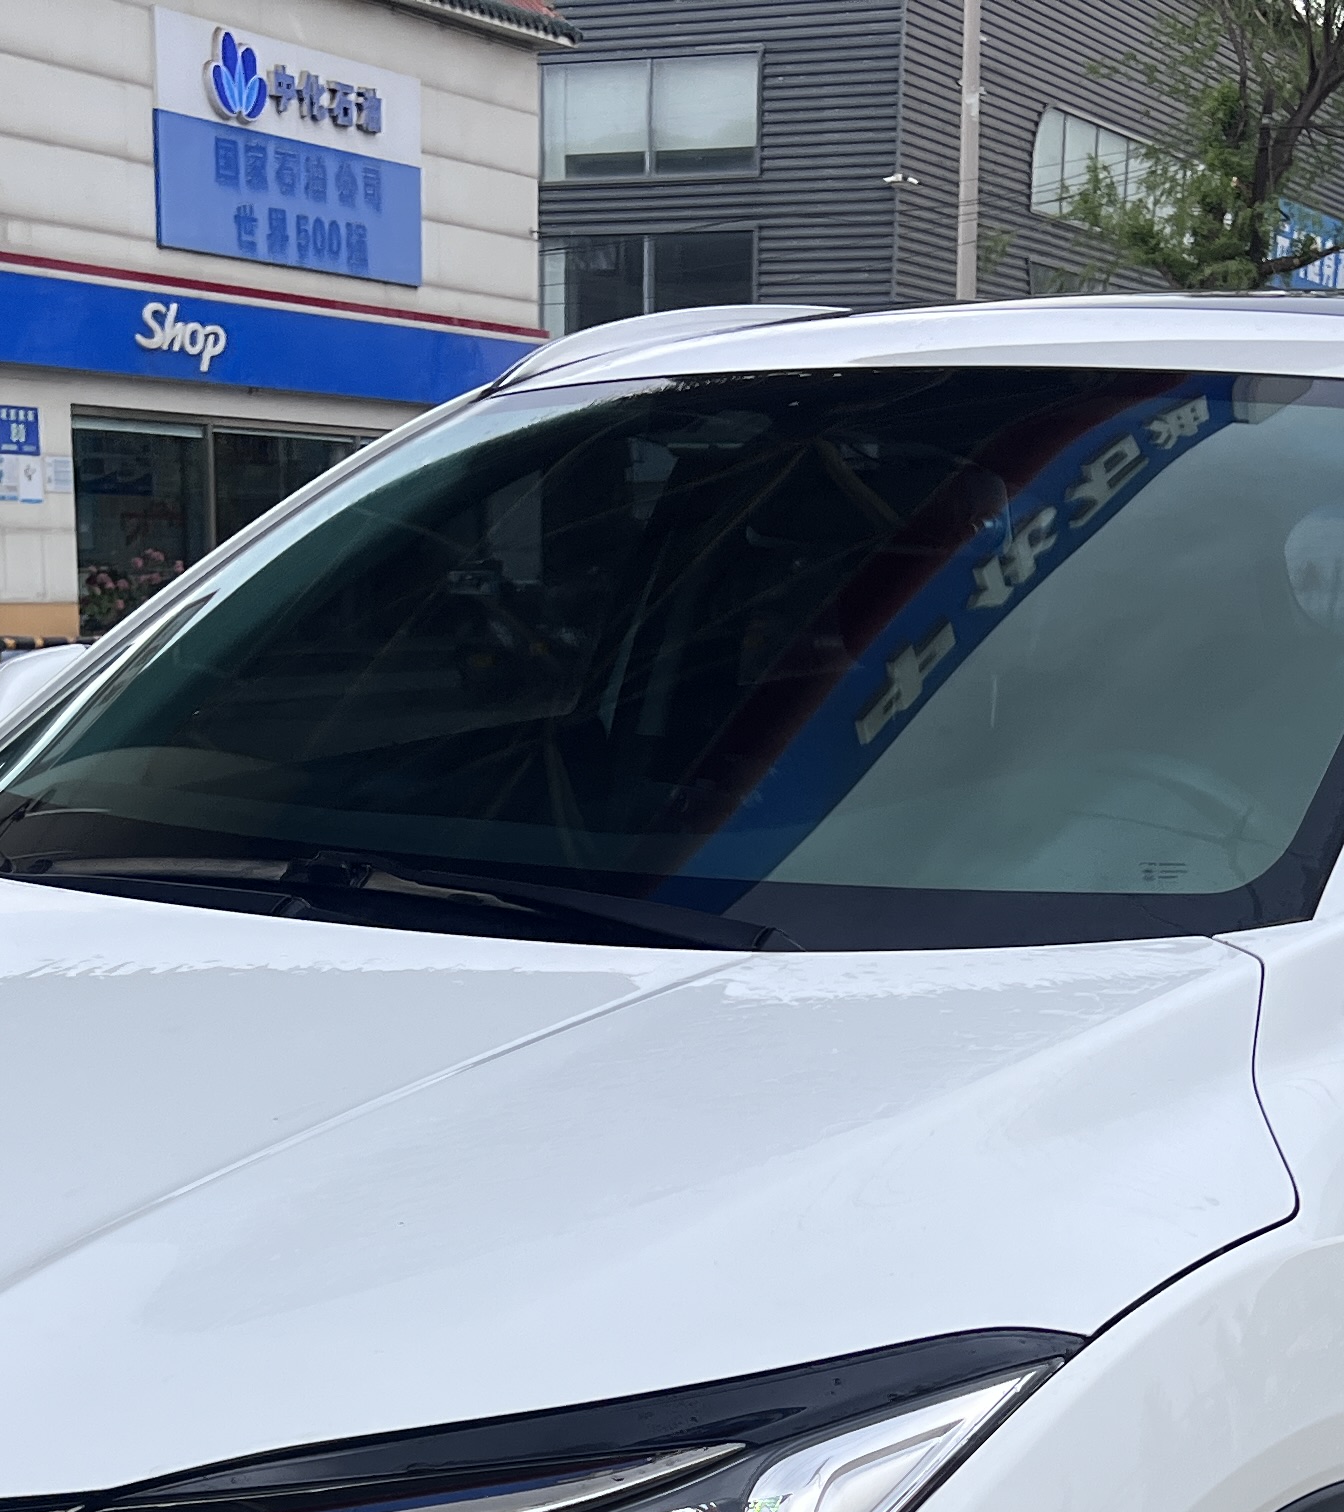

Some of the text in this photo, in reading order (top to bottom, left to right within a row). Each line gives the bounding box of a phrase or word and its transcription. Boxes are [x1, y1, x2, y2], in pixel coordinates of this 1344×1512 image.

[266, 64, 383, 135] 中化石油
[134, 301, 228, 373] Shop
